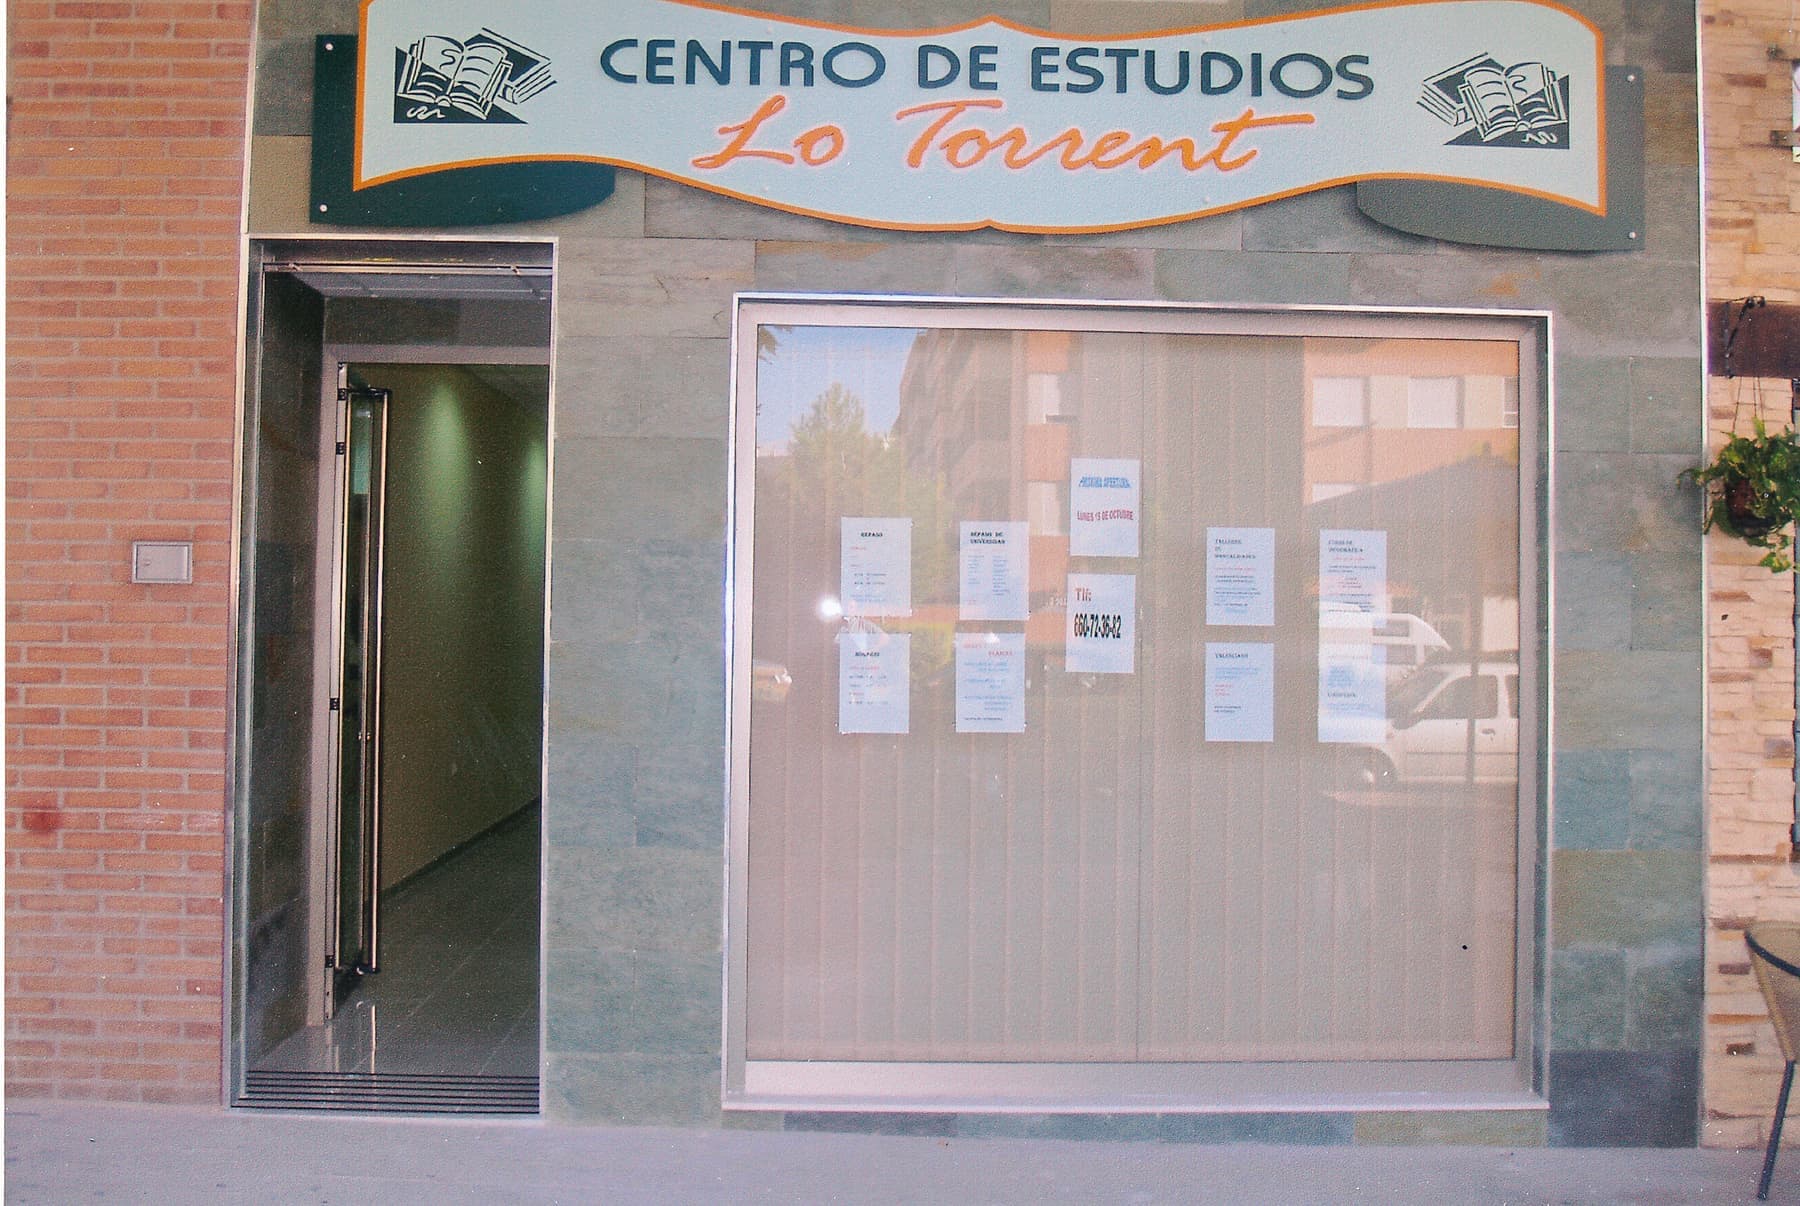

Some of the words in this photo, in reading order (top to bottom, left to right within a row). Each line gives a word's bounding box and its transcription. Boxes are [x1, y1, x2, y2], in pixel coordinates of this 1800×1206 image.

[600, 38, 887, 89] CENTRO
[917, 44, 998, 91] DE
[1031, 46, 1375, 101] ESTUDIOS
[692, 94, 845, 170] Lo
[897, 98, 1316, 172] Torrent
[1077, 510, 1094, 522] LUNES
[1102, 510, 1109, 521] DE
[1109, 508, 1134, 521] OCTUBRE
[1073, 612, 1122, 640] 660-72-36-82
